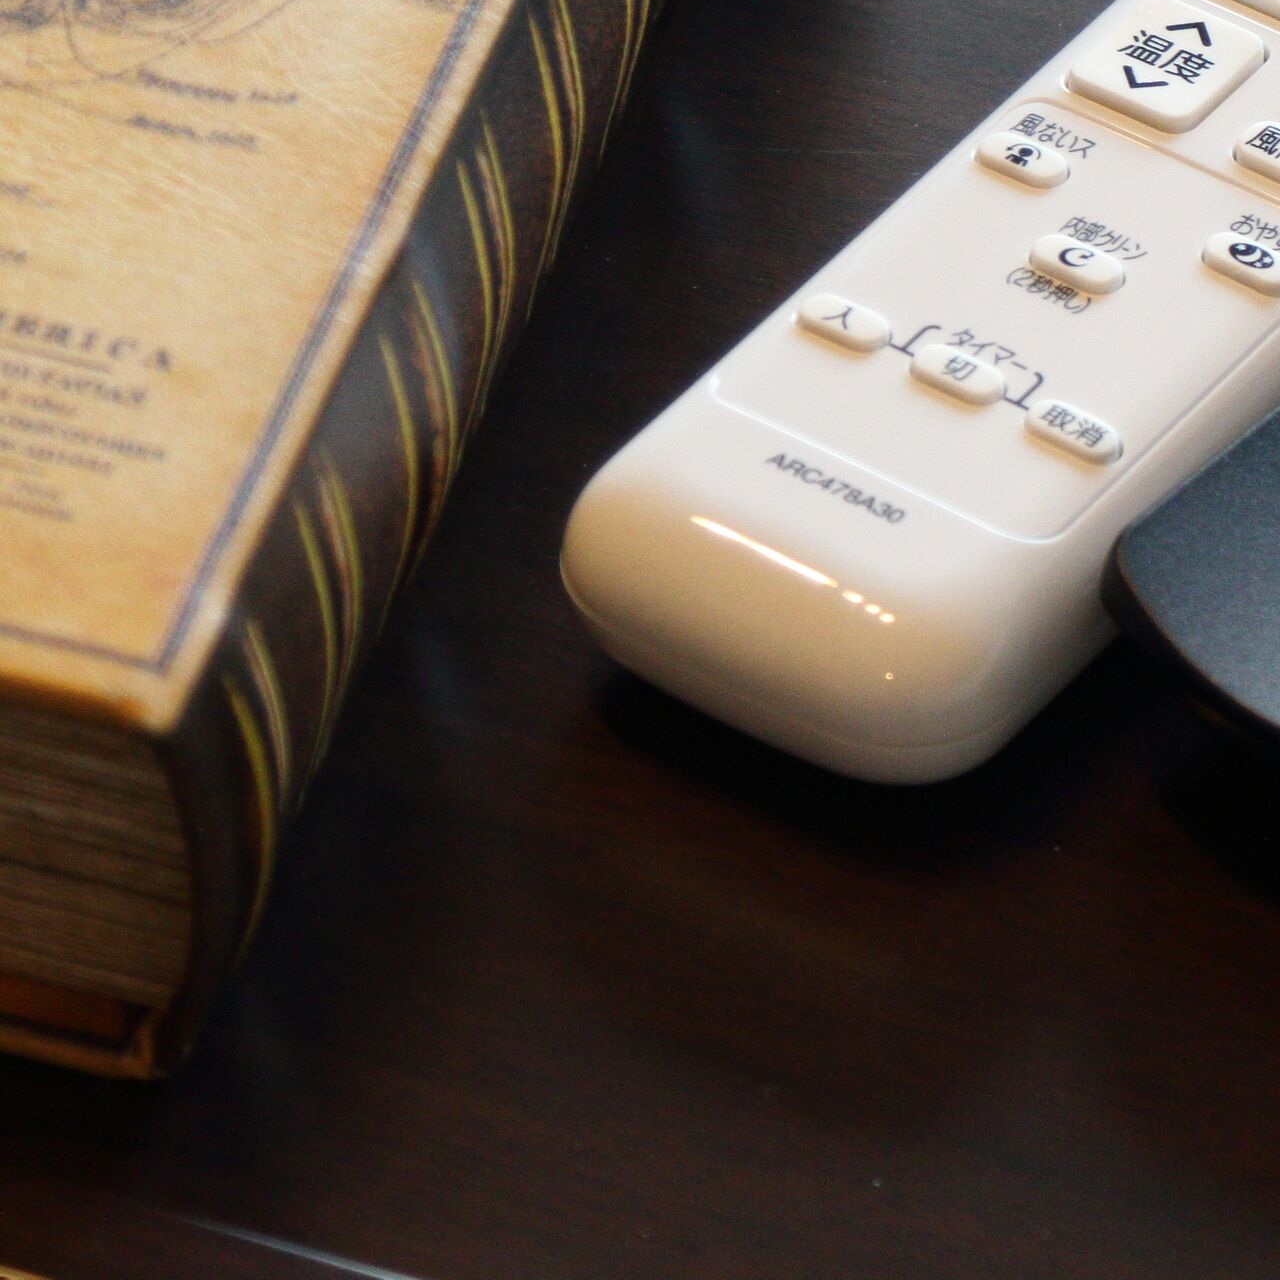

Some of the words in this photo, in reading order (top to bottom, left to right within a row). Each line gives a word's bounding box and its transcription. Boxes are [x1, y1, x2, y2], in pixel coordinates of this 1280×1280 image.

[1117, 28, 1215, 85] 温度
[1010, 113, 1096, 159] 風ないス
[1060, 217, 1147, 260] 内部クリーン
[824, 306, 854, 330] 入
[944, 356, 977, 381] 切
[947, 329, 1031, 373] タイマー
[1043, 404, 1105, 449] 取消
